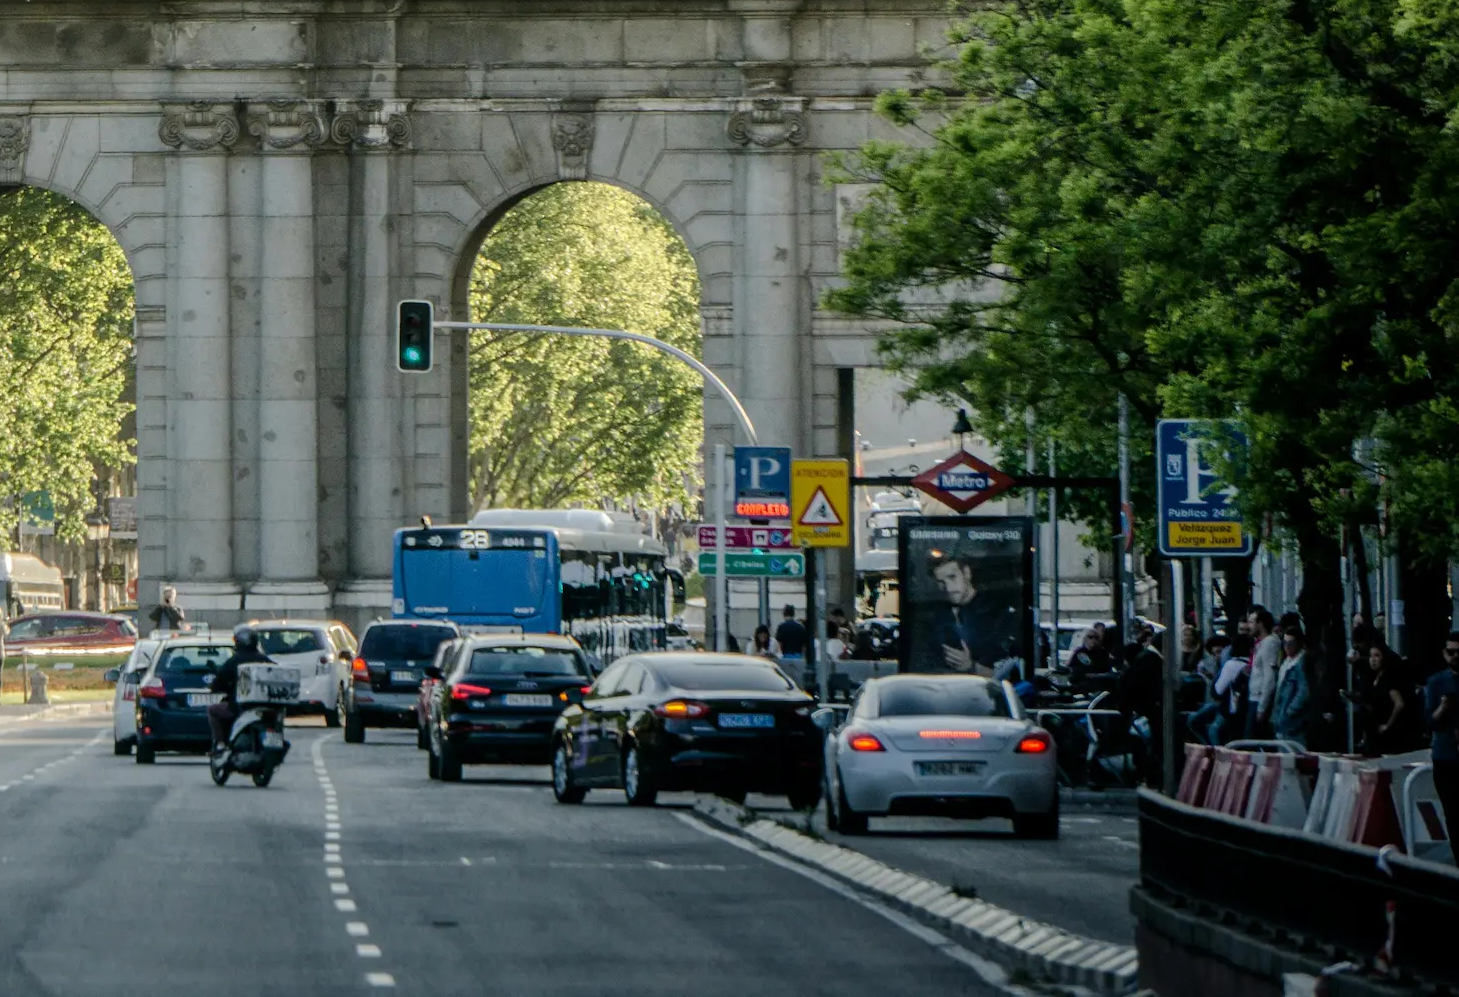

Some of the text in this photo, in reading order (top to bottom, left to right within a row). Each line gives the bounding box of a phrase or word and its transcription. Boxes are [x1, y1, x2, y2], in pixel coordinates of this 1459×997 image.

[747, 457, 781, 489] P
[941, 473, 986, 489] Metro
[736, 503, 790, 516] COMPLETO
[1176, 534, 1236, 546] Jorge Juan
